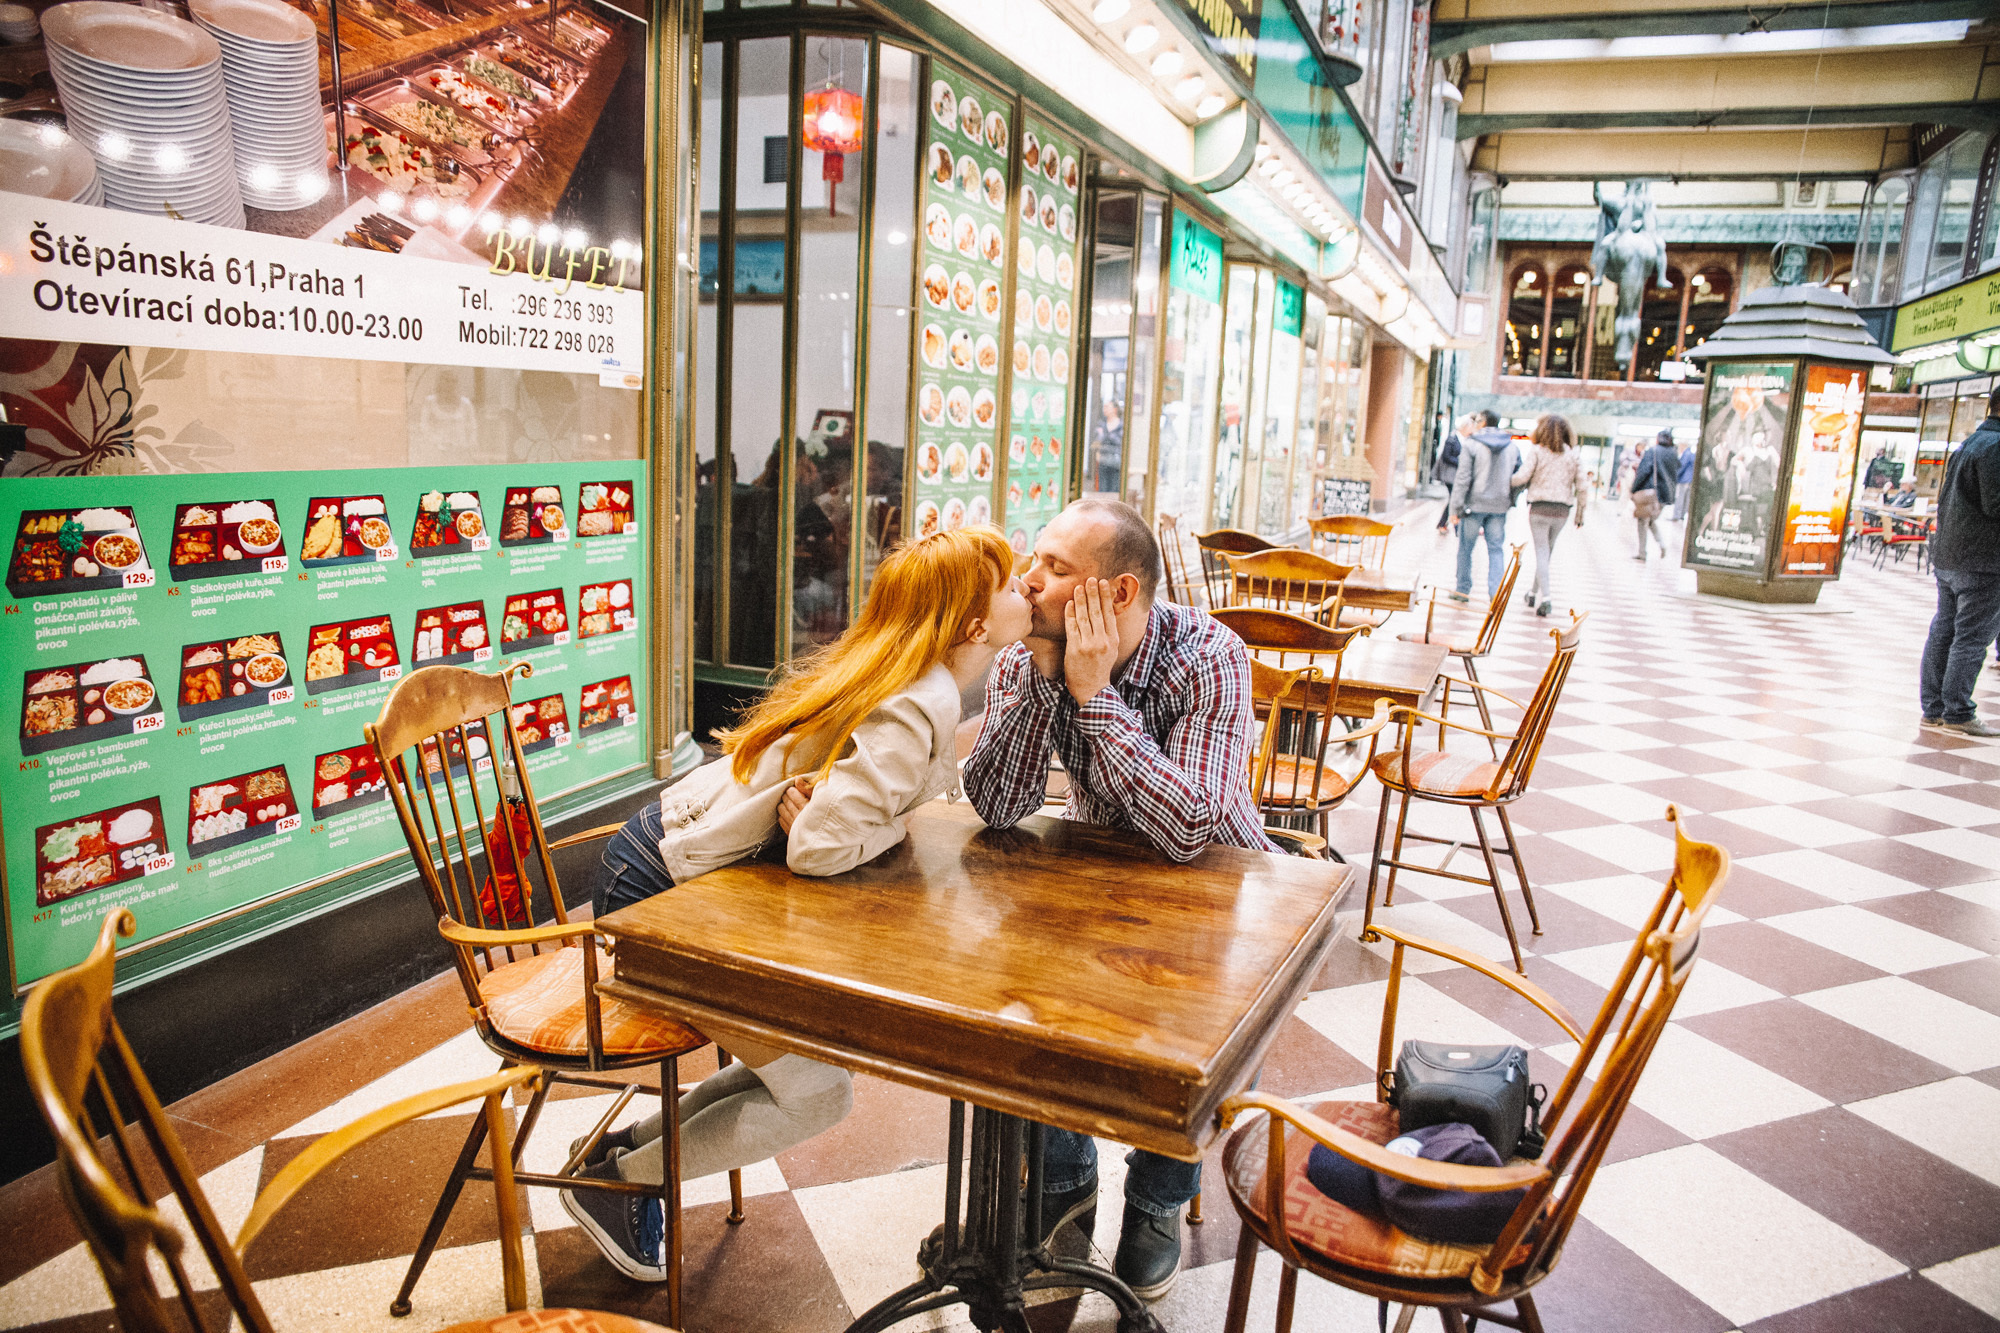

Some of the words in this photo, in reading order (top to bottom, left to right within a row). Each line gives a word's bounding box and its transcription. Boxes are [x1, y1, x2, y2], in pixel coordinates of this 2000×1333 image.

[29, 220, 216, 282] Štěpánská
[226, 257, 344, 298] 61,Praha
[354, 274, 364, 299] 1
[486, 228, 634, 295] BUFET
[33, 279, 193, 323] Otevírací
[204, 298, 423, 342] doba:10.00-23.00
[458, 285, 493, 312] Tel.
[554, 299, 582, 321] 236
[588, 303, 614, 325] 393
[458, 320, 549, 350] Mobil:722
[554, 331, 582, 352] 298
[588, 334, 614, 354] 028
[378, 548, 397, 558] 129,-
[264, 559, 287, 570] 119,-
[125, 573, 153, 584] 129,-
[167, 587, 182, 596] K5.
[190, 579, 243, 594] Sladkokyselé
[317, 591, 339, 600] ovoce
[33, 601, 58, 612] Osm
[60, 595, 100, 612] pokladů
[102, 596, 108, 604] v
[110, 592, 138, 606] pálivé
[4, 604, 22, 615] K4.
[191, 607, 217, 617] ovoce
[34, 608, 98, 625] omáčce,mini
[36, 639, 68, 651] ovoce
[382, 668, 401, 678] 149,-
[271, 690, 293, 701] 109,-
[136, 717, 163, 729] 129,-
[176, 726, 195, 737] K11.
[46, 748, 87, 766] Vepřové
[89, 749, 96, 757] s
[97, 737, 149, 754] bambusem
[200, 743, 225, 755] ovoce
[19, 759, 42, 771] K10.
[48, 770, 54, 778] a
[56, 753, 126, 776] houbami,salát,
[50, 789, 80, 803] ovoce
[278, 818, 300, 831] 129,-
[329, 837, 350, 849] ovoce
[147, 857, 173, 871] 109,-
[207, 857, 222, 868] 8ks
[59, 901, 84, 915] Kuře
[86, 897, 98, 907] se
[99, 881, 145, 904] žampiony,
[61, 911, 94, 927] ledový
[158, 881, 179, 894] maki
[33, 910, 56, 924] K17.
